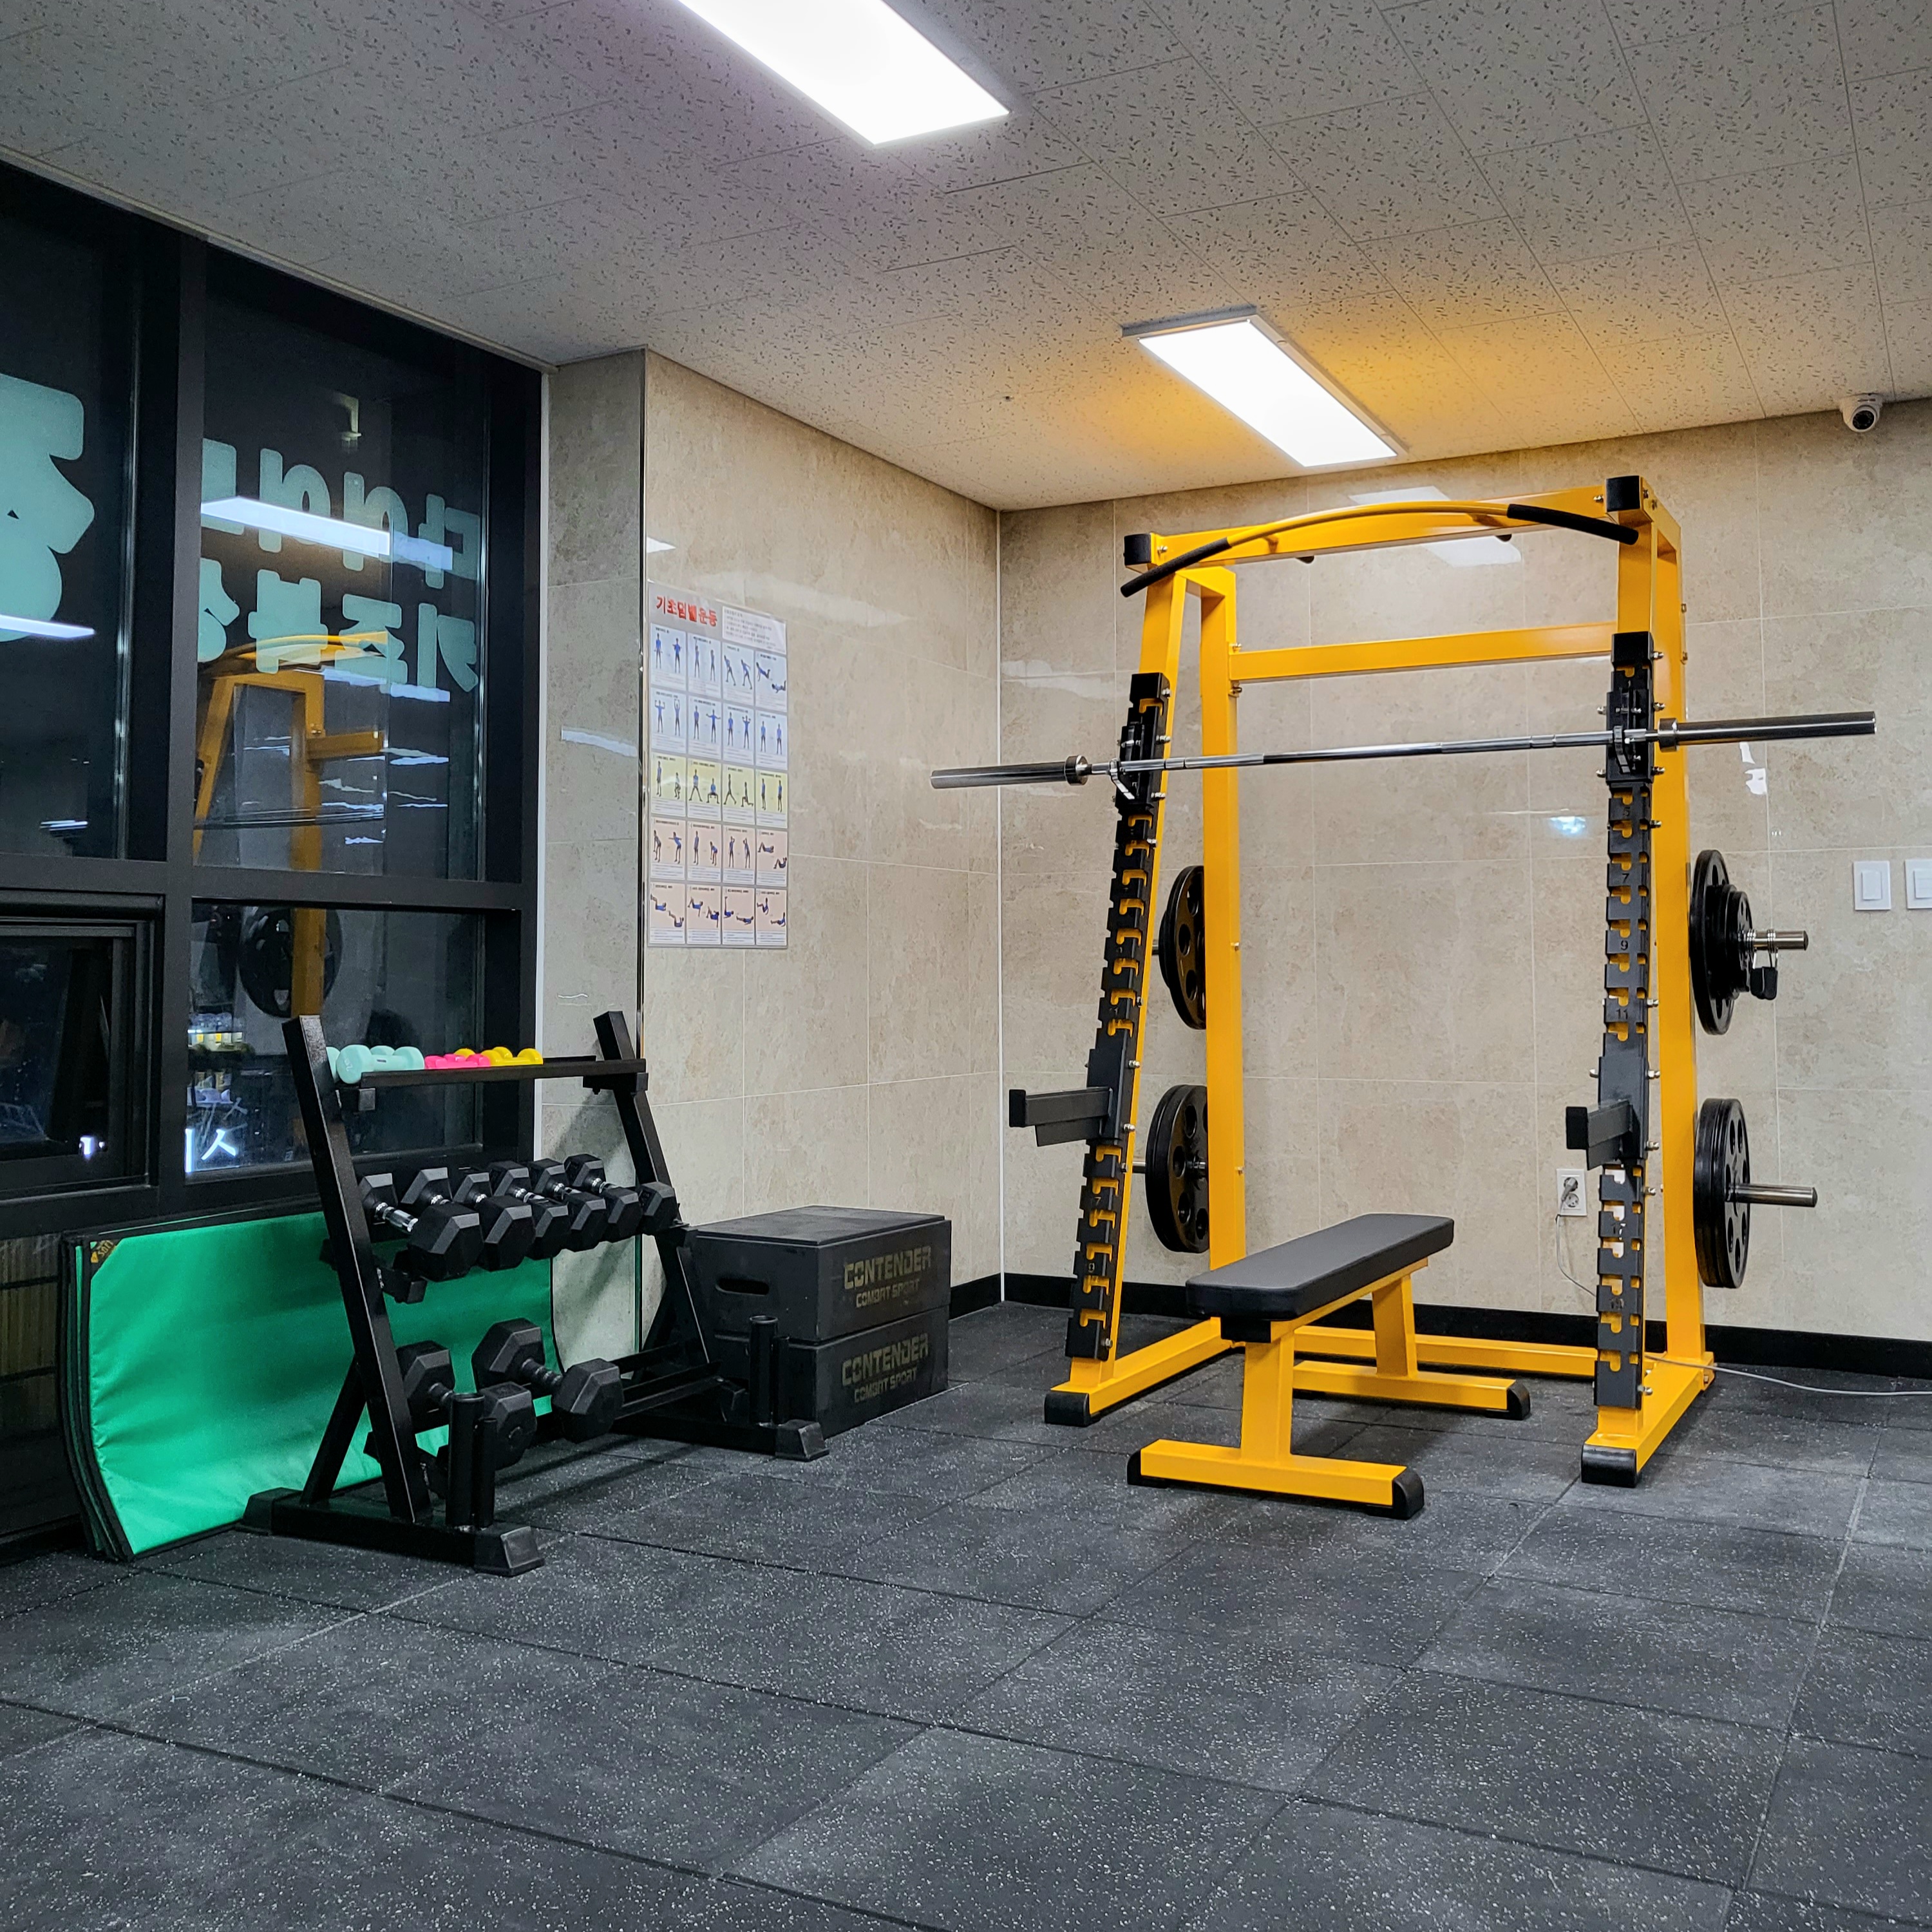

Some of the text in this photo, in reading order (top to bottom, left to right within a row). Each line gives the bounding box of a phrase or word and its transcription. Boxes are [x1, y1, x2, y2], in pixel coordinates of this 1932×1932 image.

[1622, 873, 1629, 884] 7
[1620, 940, 1629, 951] 9
[1616, 1009, 1628, 1019] 11
[844, 1245, 931, 1289] CONTENDER
[856, 1278, 920, 1308] COMBAT SPORT
[842, 1333, 929, 1386] CONTENDER
[855, 1366, 917, 1403] COMBAT SPORT
